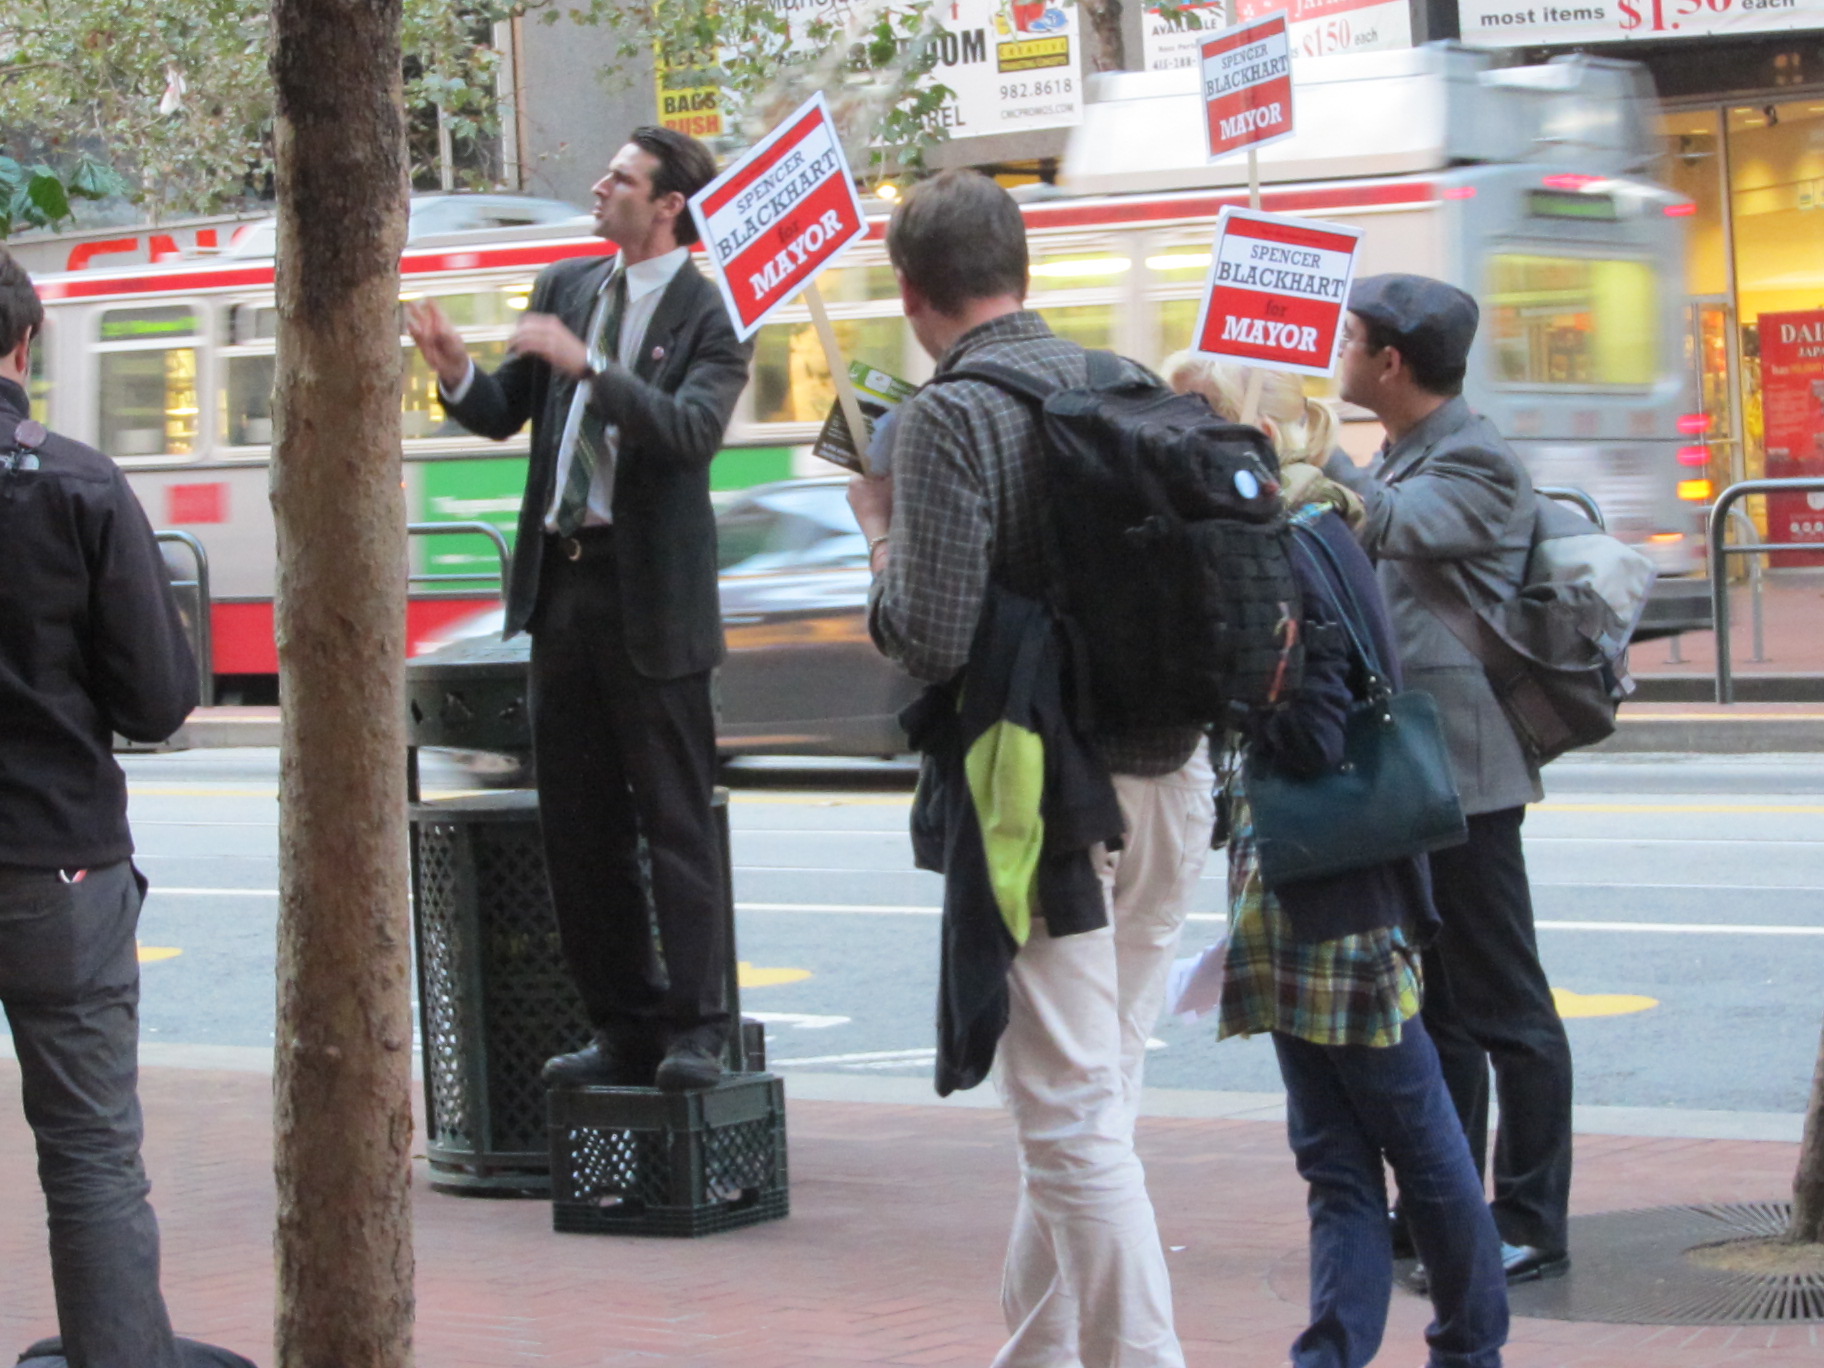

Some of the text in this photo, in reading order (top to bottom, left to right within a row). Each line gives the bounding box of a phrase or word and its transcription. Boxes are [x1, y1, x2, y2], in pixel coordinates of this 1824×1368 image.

[1480, 9, 1535, 27] most
[1543, 7, 1605, 24] items
[1354, 27, 1378, 46] each
[1222, 44, 1268, 70] SPENCER
[1206, 55, 1288, 96] BLACKHART
[1000, 78, 1072, 100] 982.8618
[664, 92, 716, 114] BAGS
[1219, 102, 1282, 140] MAYOR
[736, 151, 805, 214] SPENCER
[717, 149, 838, 260] BLACKHART
[777, 220, 799, 244] for
[749, 209, 843, 300] MAYOR
[1250, 244, 1321, 269] SPENCER
[1217, 261, 1344, 298] BLACKHART
[1265, 300, 1287, 318] for
[1220, 315, 1318, 353] MAYOR
[1780, 322, 1824, 343] DAI
